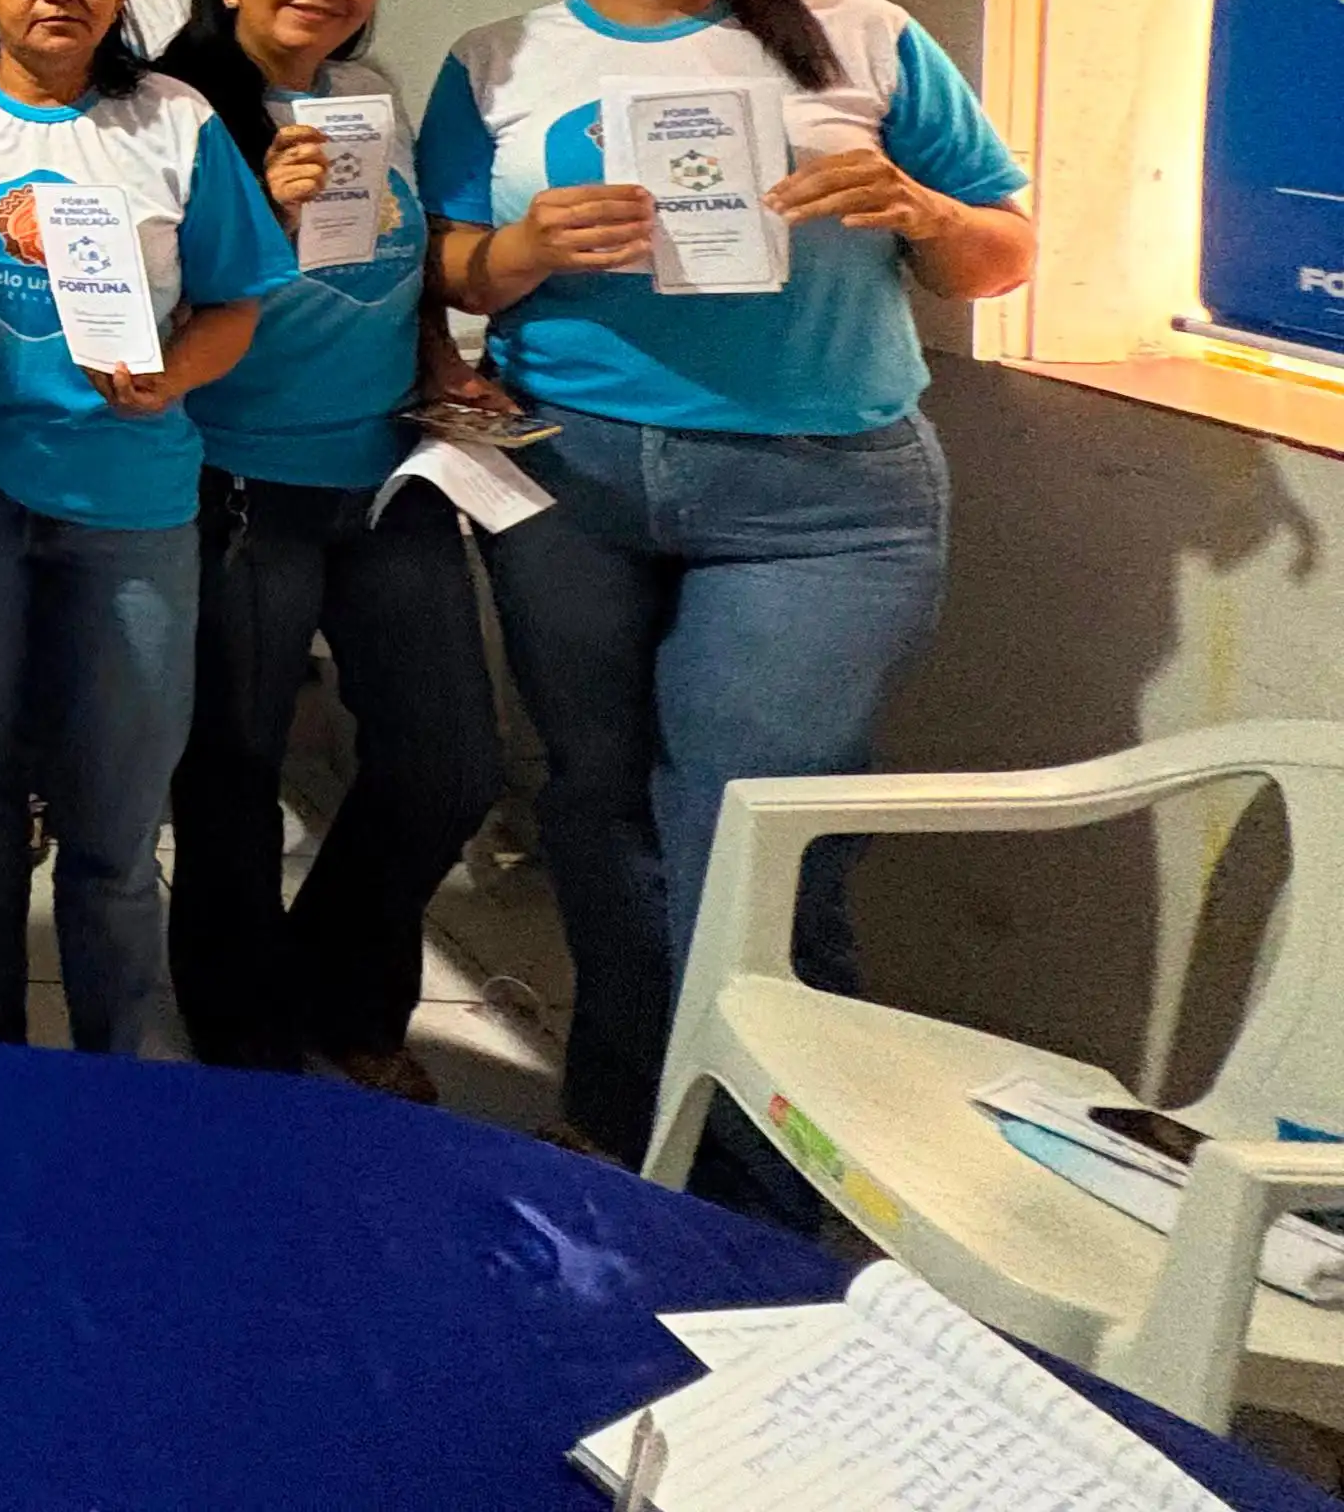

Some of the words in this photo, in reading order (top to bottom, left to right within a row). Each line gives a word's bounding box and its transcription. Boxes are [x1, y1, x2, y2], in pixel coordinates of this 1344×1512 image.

[313, 190, 370, 202] ORTUNA
[654, 198, 748, 213] FORTUNA
[58, 279, 132, 294] FORTUNA
